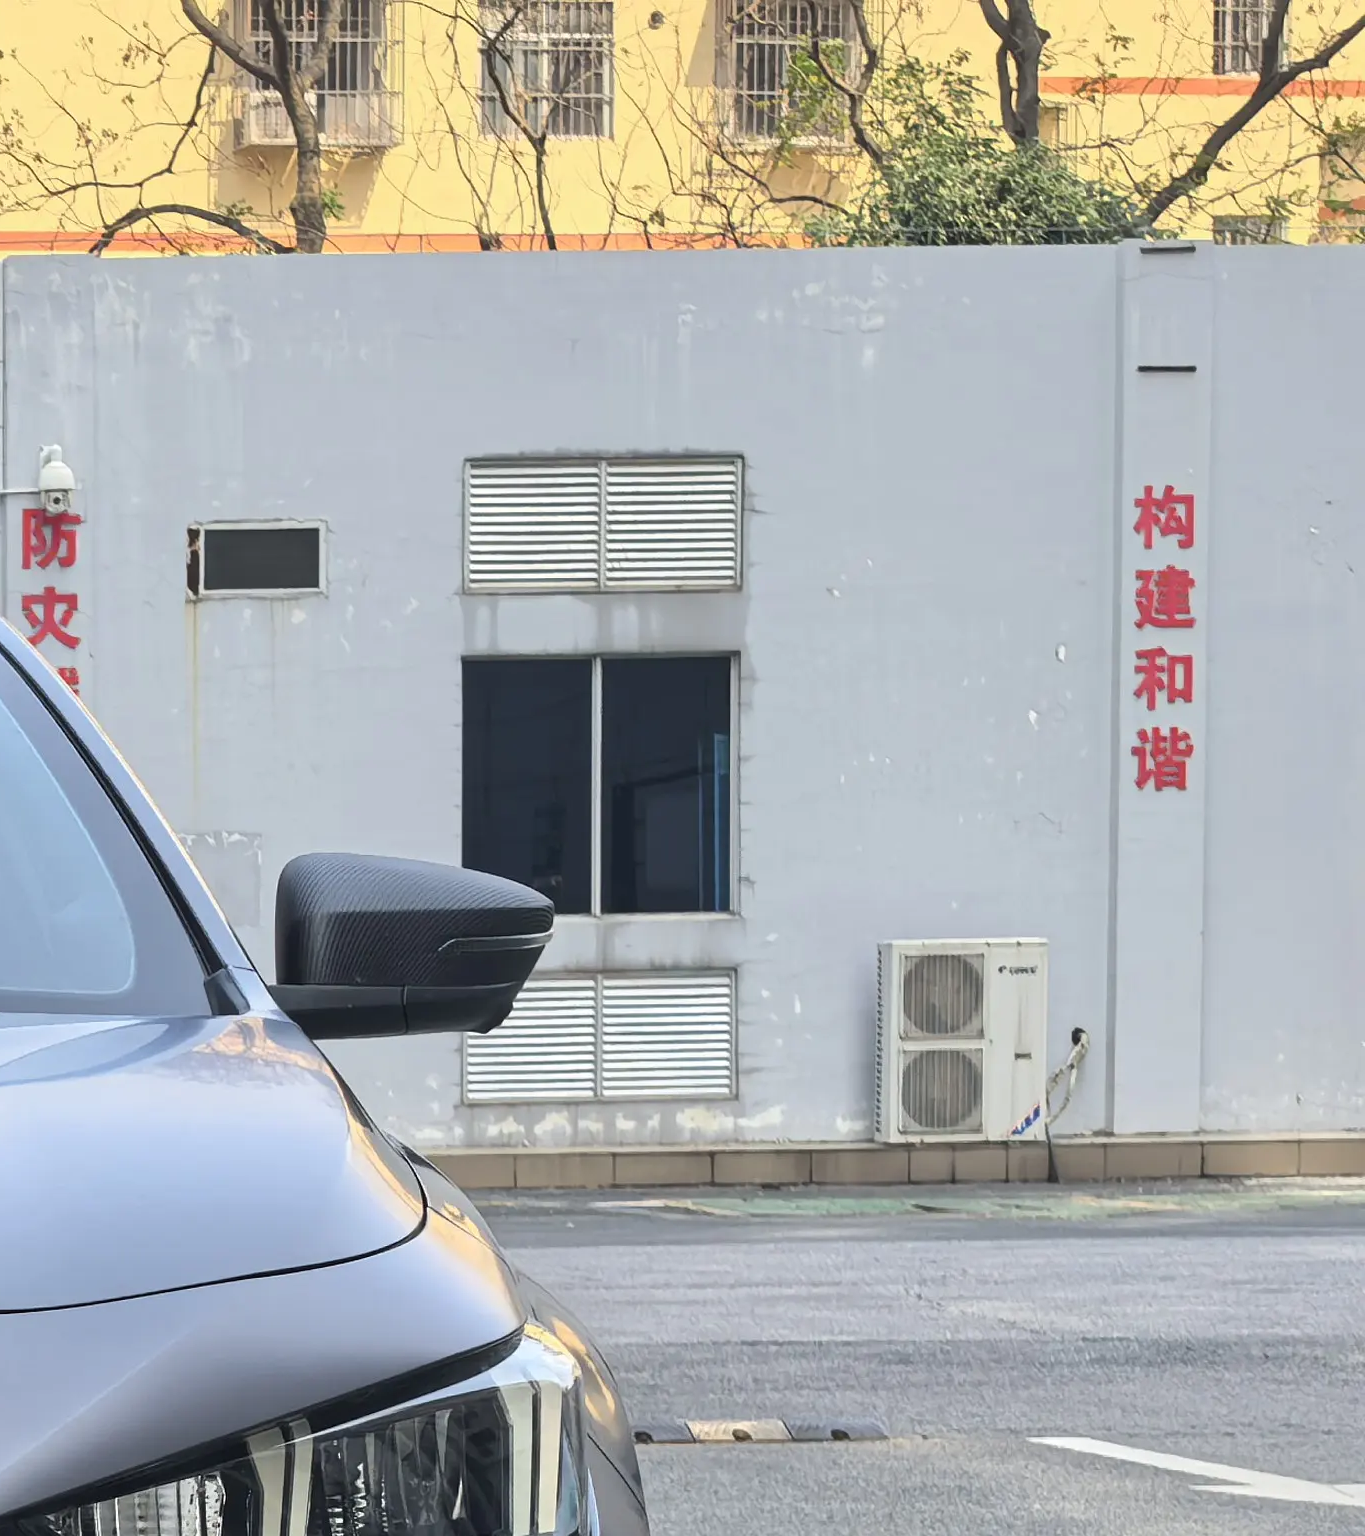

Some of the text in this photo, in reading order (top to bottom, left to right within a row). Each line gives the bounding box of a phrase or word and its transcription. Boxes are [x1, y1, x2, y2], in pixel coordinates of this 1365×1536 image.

[22, 508, 82, 696] 防灾
[1131, 484, 1197, 792] 构建和谐
